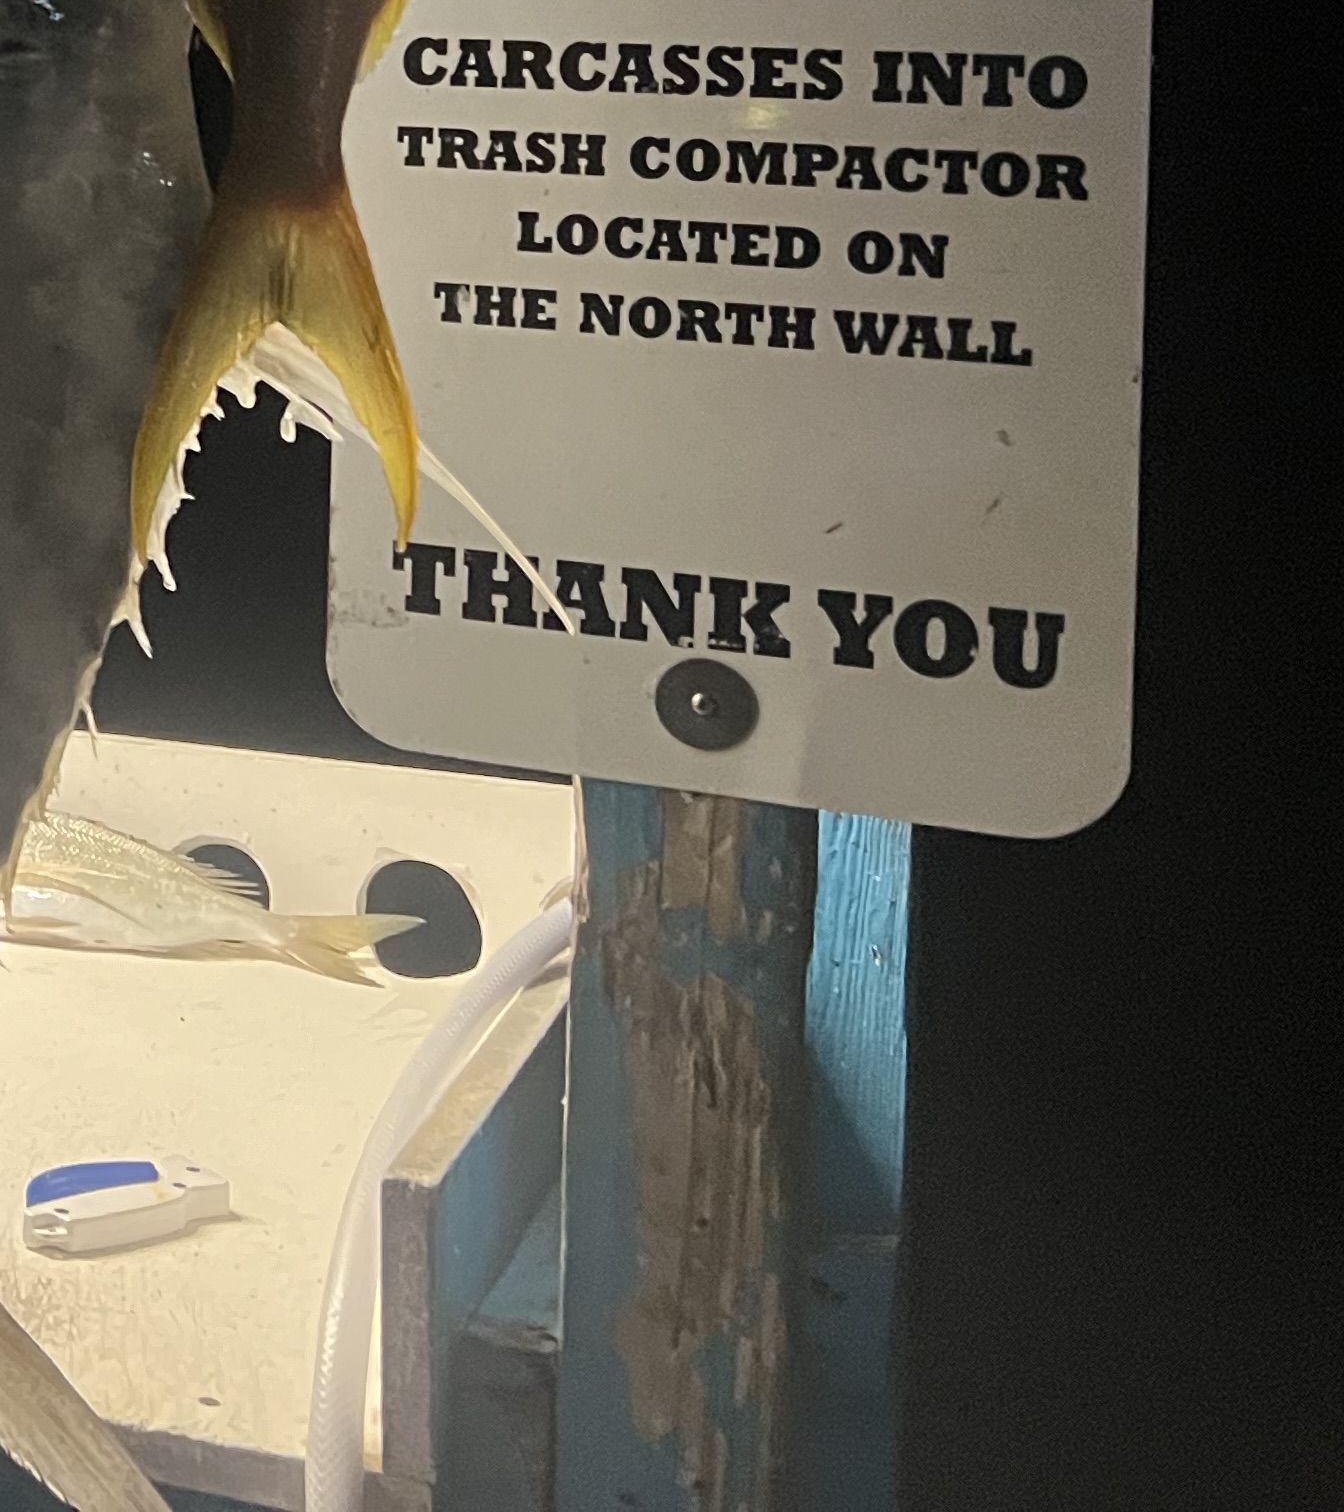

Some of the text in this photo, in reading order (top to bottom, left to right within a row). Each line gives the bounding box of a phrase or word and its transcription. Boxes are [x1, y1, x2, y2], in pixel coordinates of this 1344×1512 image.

[404, 37, 1088, 110] CARCASSES INTO
[398, 127, 1089, 201] TRASH COMPACTOR
[518, 212, 949, 279] LOCATED ON
[435, 283, 1033, 366] THE NORTH WALL
[393, 541, 1065, 689] THANK YOU
